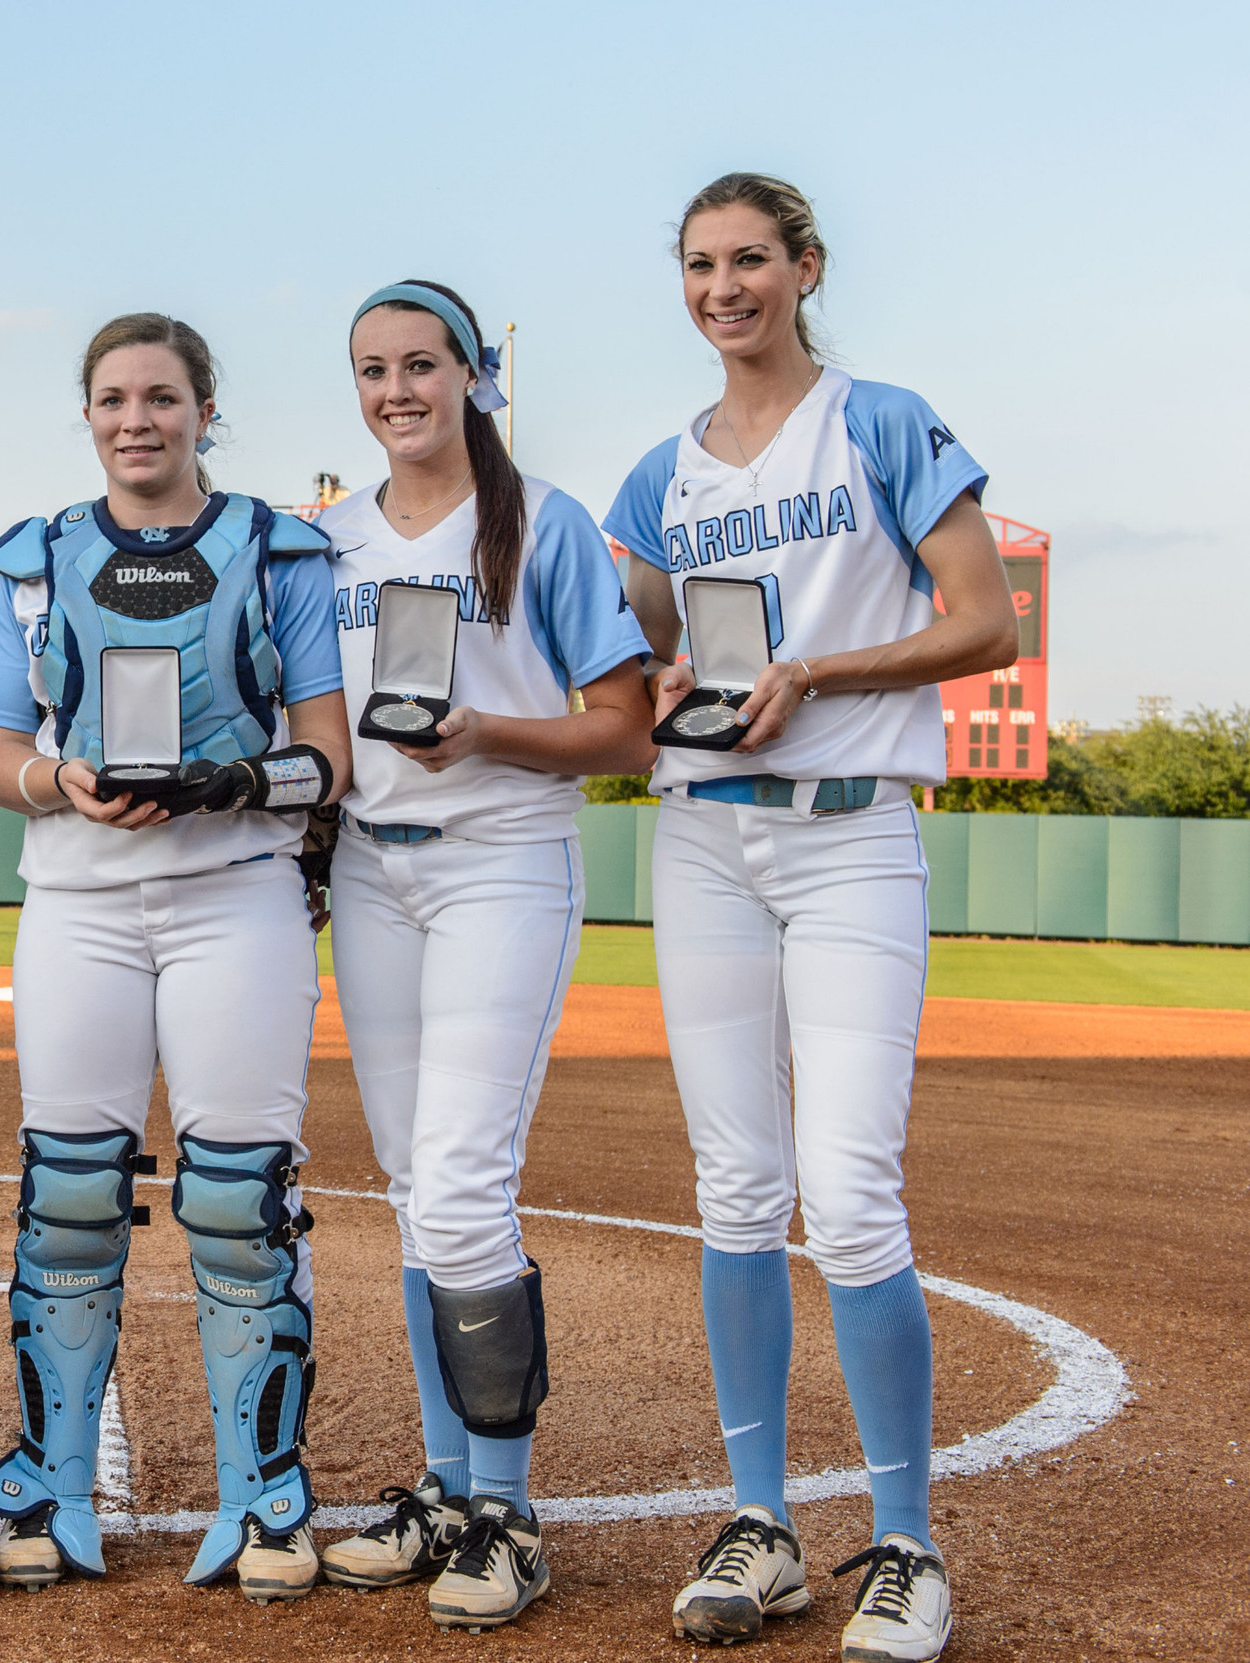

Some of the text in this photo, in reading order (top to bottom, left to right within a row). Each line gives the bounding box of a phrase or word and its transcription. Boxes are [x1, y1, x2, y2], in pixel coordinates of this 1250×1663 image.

[664, 485, 857, 574] CAROLINA
[115, 567, 193, 584] Wilson
[970, 709, 999, 724] HITS
[1010, 710, 1035, 725] ERR
[43, 1272, 100, 1287] Wilson
[206, 1276, 258, 1298] Wilson
[481, 1501, 509, 1518] NIKE
